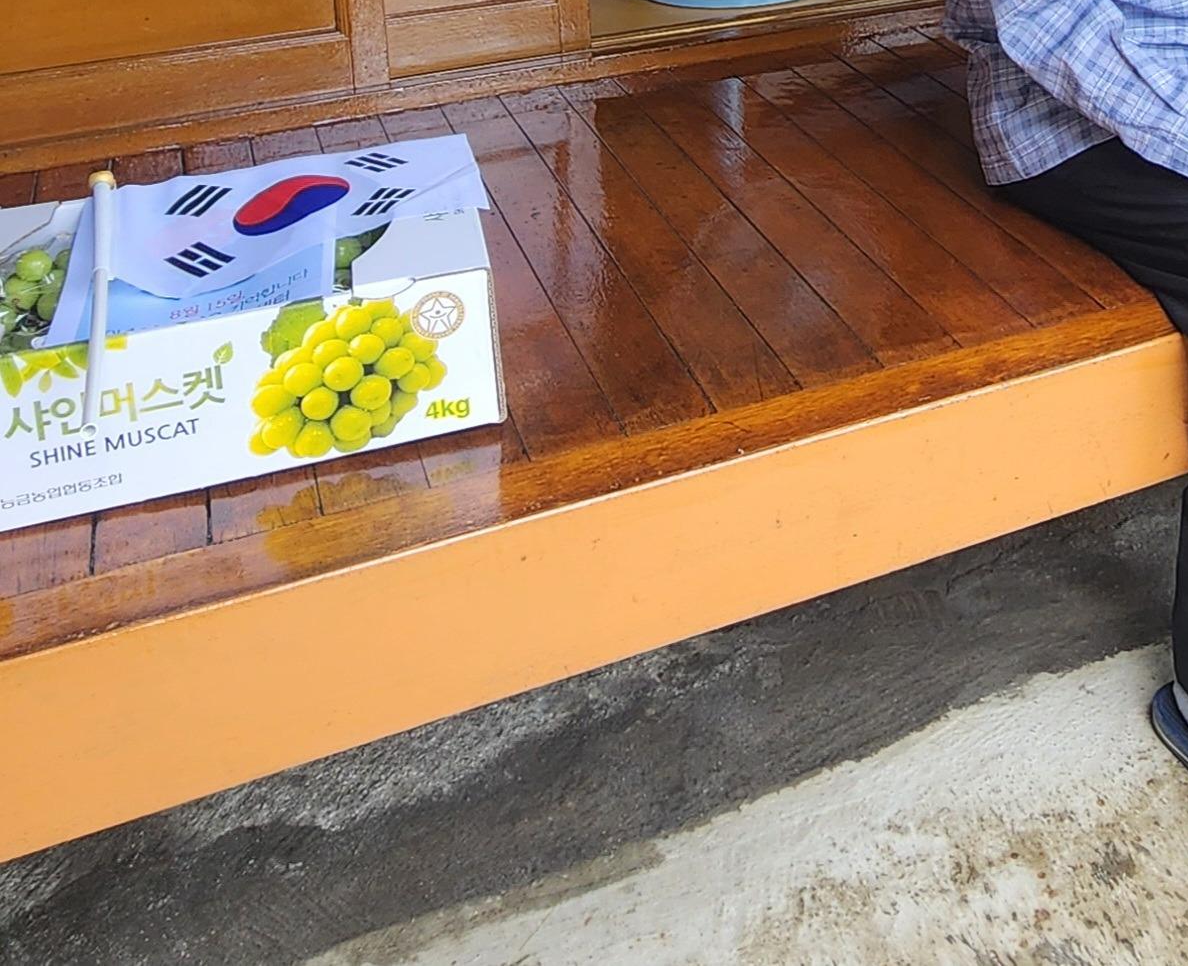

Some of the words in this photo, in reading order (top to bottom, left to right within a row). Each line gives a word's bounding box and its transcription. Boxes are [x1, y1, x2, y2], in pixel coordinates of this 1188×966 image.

[425, 397, 470, 419] 4kg
[29, 439, 97, 469] SHINE
[104, 417, 200, 453] MUSCAT
